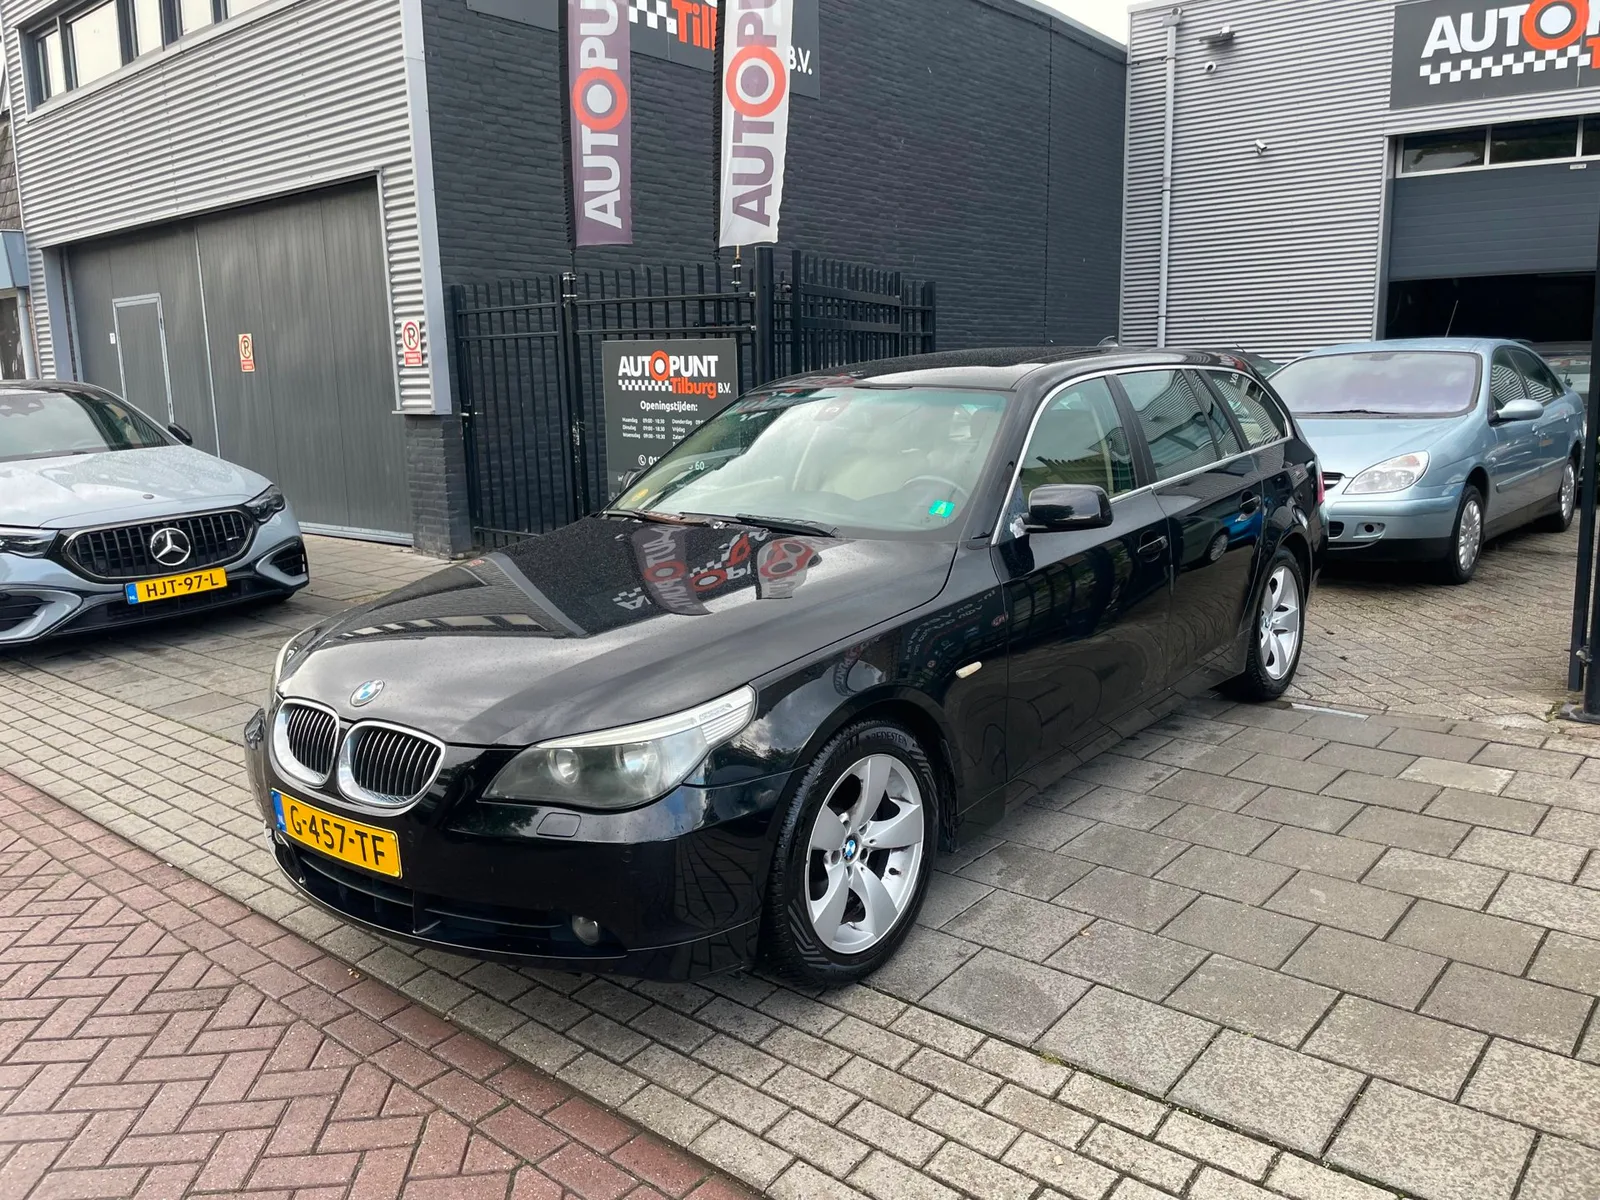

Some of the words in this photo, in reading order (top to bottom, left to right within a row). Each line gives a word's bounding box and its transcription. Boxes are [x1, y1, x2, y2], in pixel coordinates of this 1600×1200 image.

[726, 0, 786, 227] AUTOP
[618, 350, 719, 381] AUTOPUNT
[670, 377, 716, 399] Tilburg
[718, 382, 732, 394] B.V.
[640, 400, 698, 412] Openingstijden:
[145, 573, 219, 598] HJT-97-L
[290, 805, 385, 866] G-457-TF
